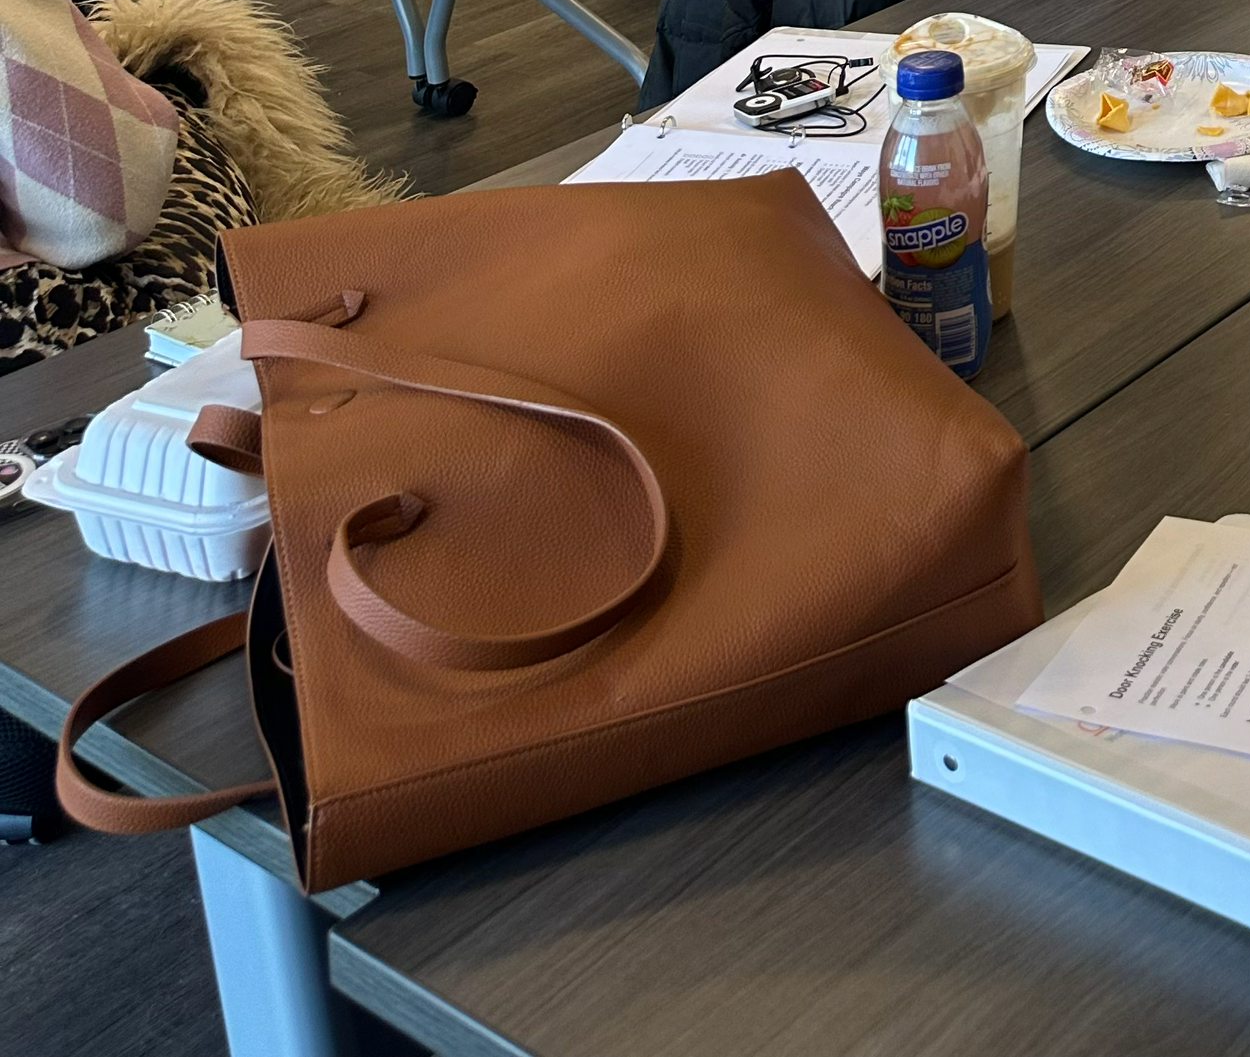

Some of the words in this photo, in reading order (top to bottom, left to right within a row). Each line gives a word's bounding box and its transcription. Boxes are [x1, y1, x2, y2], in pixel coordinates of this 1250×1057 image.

[888, 216, 963, 250] snapple
[907, 280, 933, 291] Facts
[915, 312, 932, 323] 180
[1109, 679, 1132, 698] Door
[1126, 642, 1162, 677] Knocking
[1152, 609, 1183, 640] Exercise
